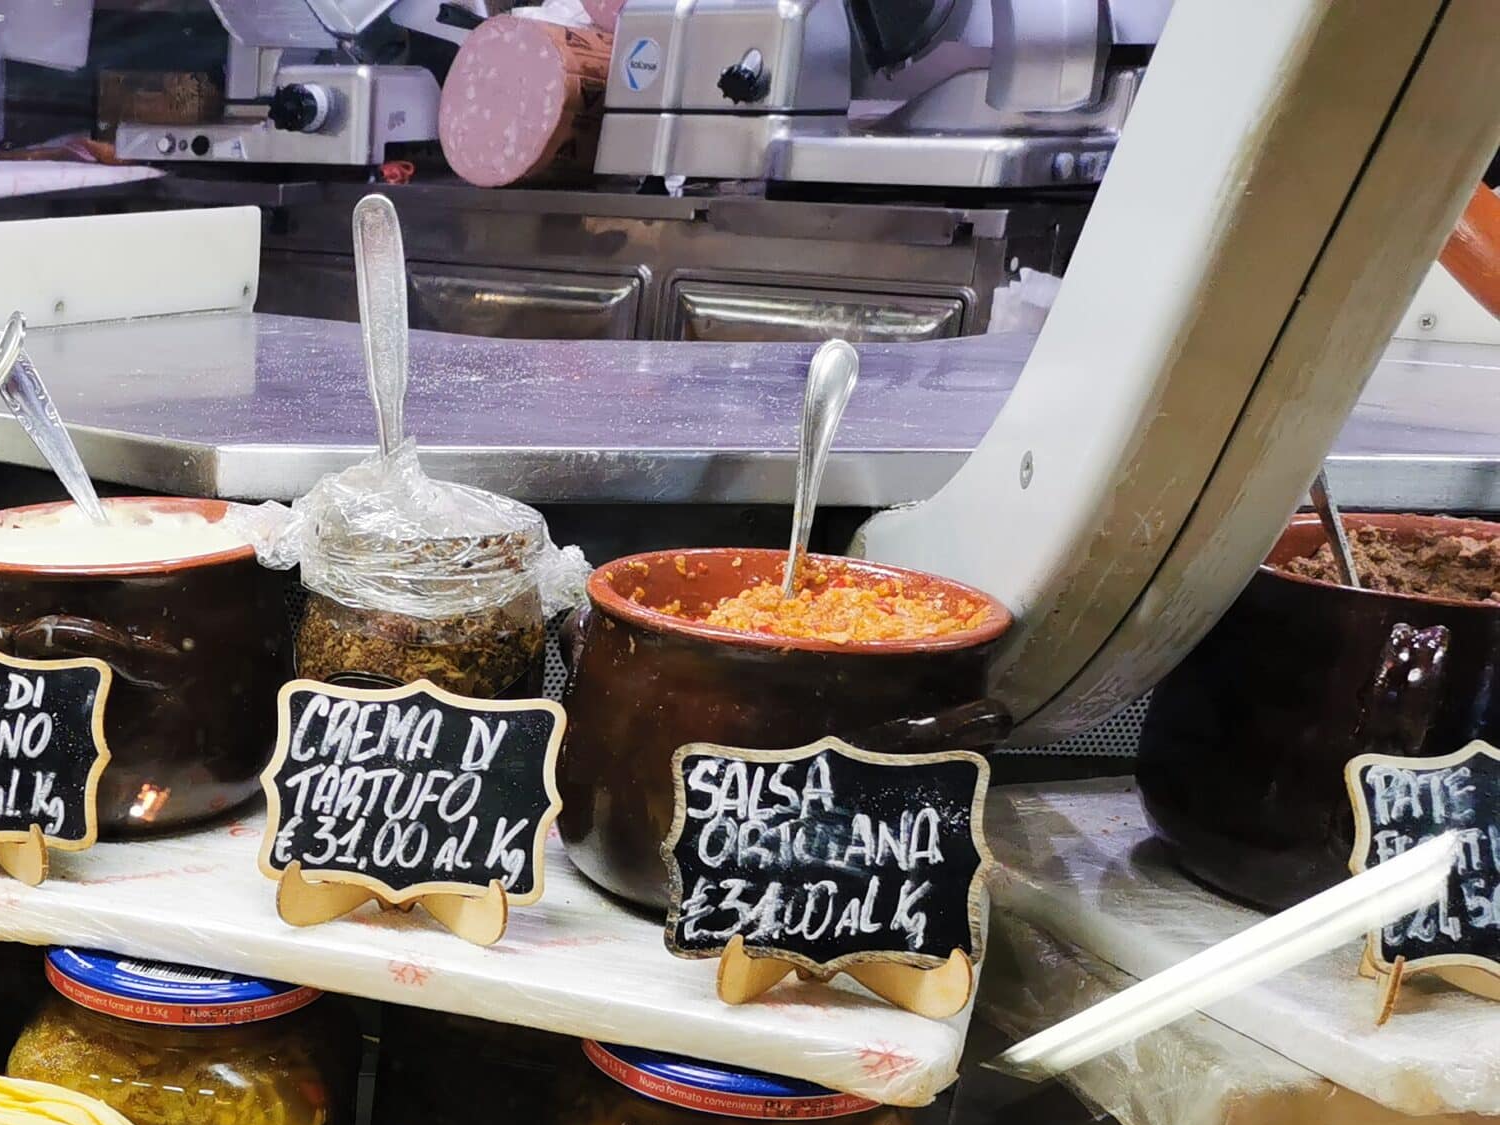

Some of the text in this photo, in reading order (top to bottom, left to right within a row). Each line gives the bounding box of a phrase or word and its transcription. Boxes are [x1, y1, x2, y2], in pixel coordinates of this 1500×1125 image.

[4, 672, 45, 710] DI
[290, 693, 508, 771] CREMA DI
[285, 763, 482, 823] TARTUFO
[687, 754, 835, 821] SALSA
[638, 1074, 665, 1093] Nuovo
[665, 1082, 703, 1103] formato
